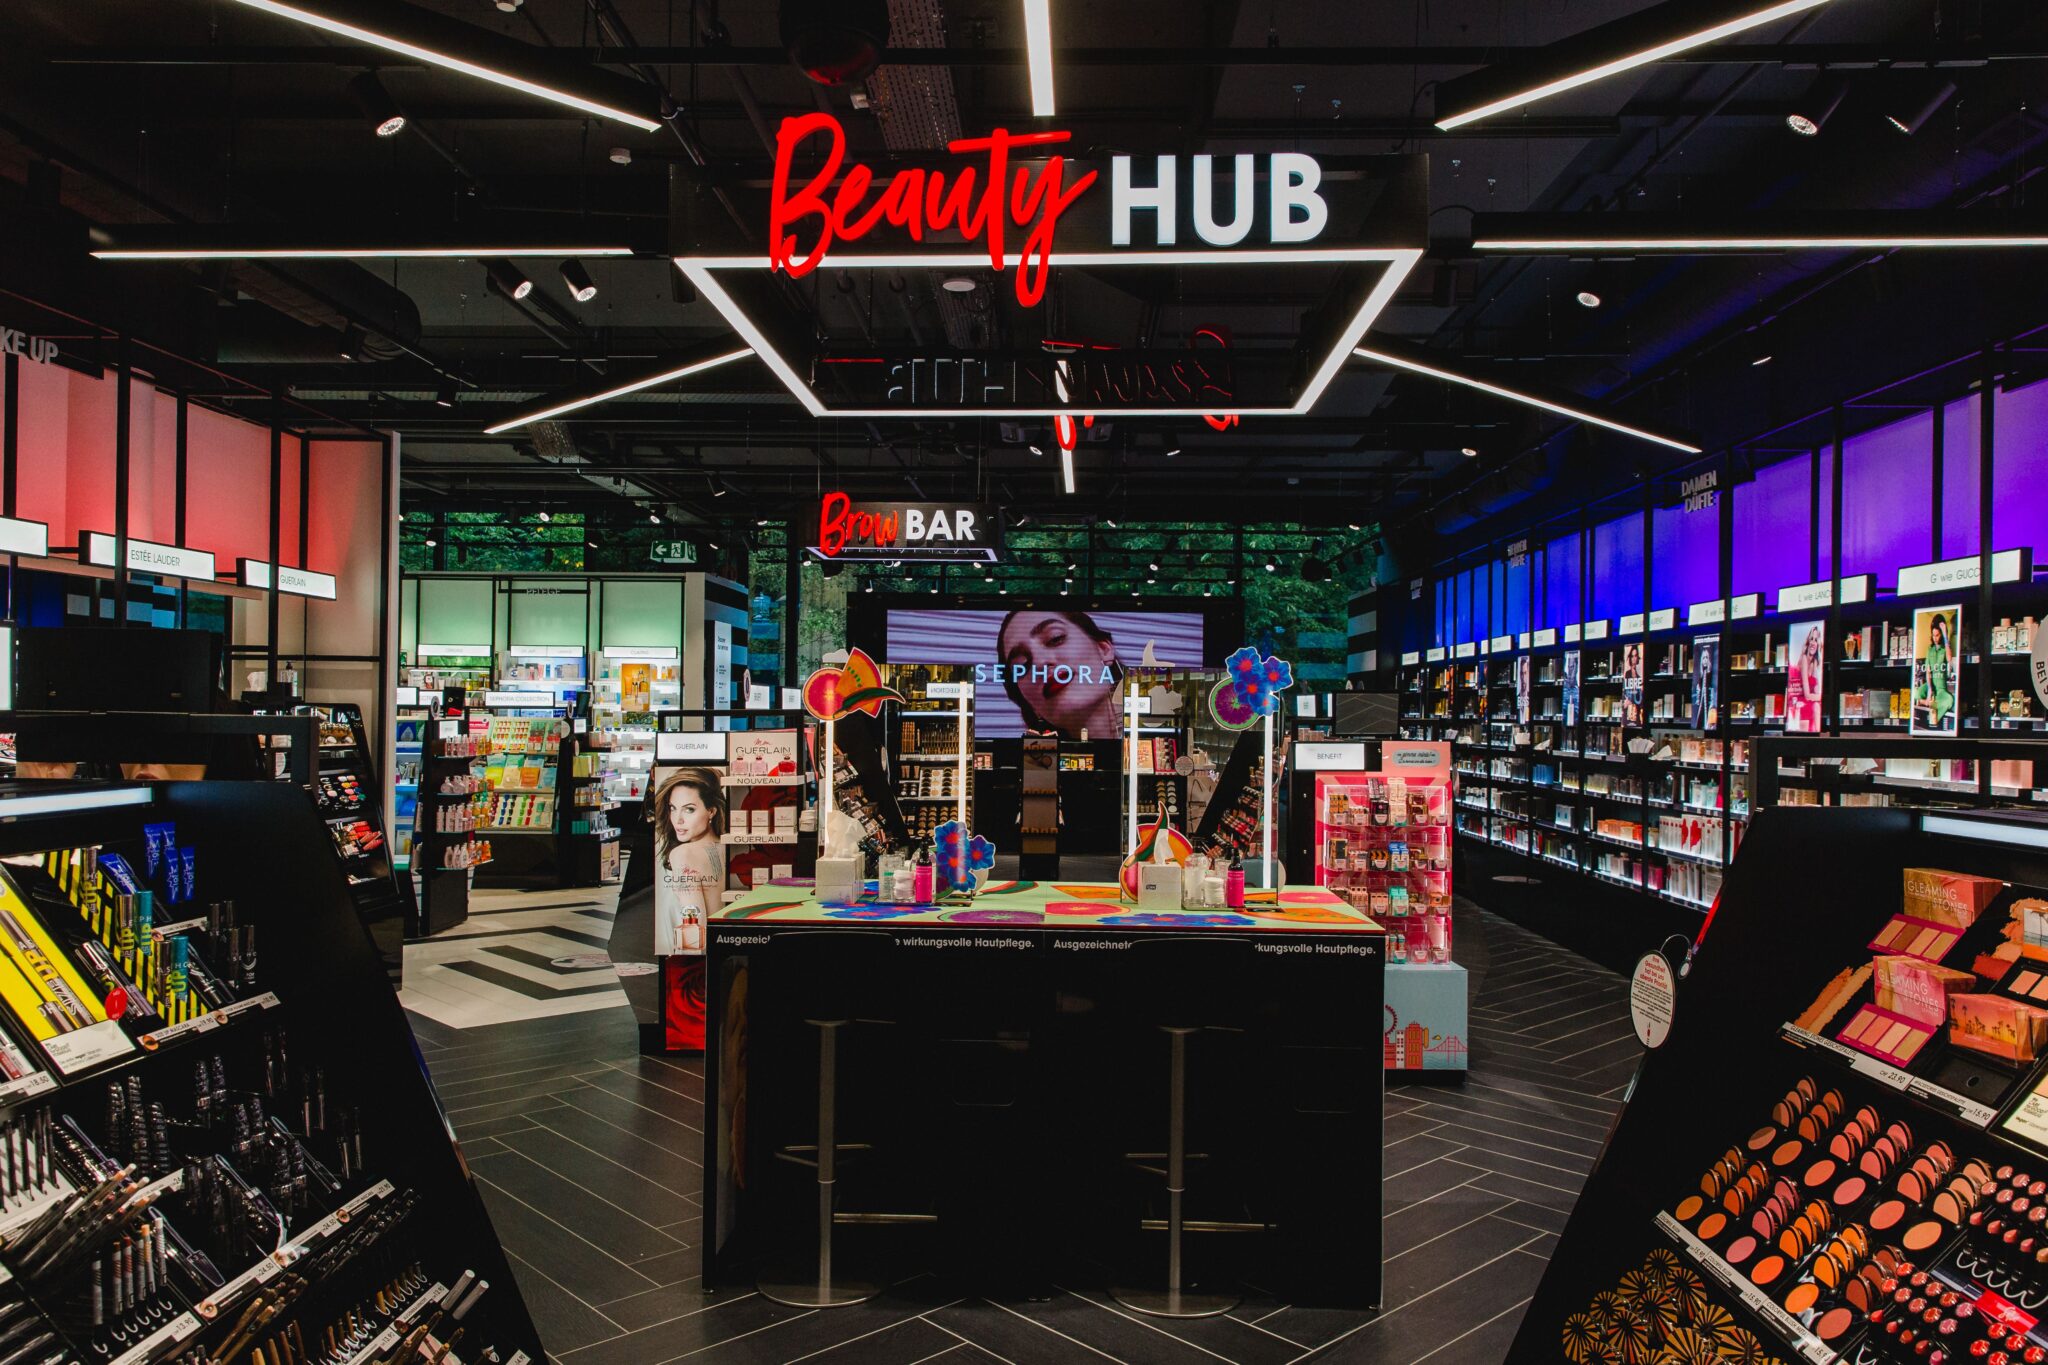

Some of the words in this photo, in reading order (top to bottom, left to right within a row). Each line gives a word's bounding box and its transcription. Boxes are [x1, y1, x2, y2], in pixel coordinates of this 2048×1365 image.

[770, 112, 1098, 307] Beauty
[1111, 152, 1328, 248] HUB
[30, 336, 59, 366] UP
[1681, 470, 1718, 496] DAMEN
[1685, 489, 1714, 513] DÜFTE
[820, 491, 898, 557] Brow
[905, 509, 976, 542] BAR
[131, 549, 152, 562] ESTÉE
[153, 553, 181, 566] LAUDER
[280, 574, 306, 587] GUERLAIN
[1930, 573, 1937, 583] G
[1940, 572, 1953, 582] wie
[1956, 567, 1981, 580] GUCC
[1815, 589, 1832, 600] LANC
[976, 663, 1115, 685] SEPHORA
[1625, 678, 1643, 690] LIBRE
[736, 746, 791, 755] GUERLAIN
[1317, 752, 1342, 760] BENEFIT
[664, 875, 719, 883] GUERLAIN
[1907, 880, 1957, 899] GLEAMING
[1932, 898, 1968, 913] STONES
[903, 936, 972, 949] wirkungsvolle
[975, 936, 1035, 949] Hautpflege.
[1315, 943, 1376, 956] Hautpflege.
[1878, 968, 1928, 994] GLEAMING
[1903, 991, 1939, 1012] STONES
[170, 1022, 191, 1033] MASCARA
[1888, 1071, 1906, 1084] 23.90
[1972, 1107, 1991, 1121] 15.90
[1747, 1293, 1762, 1306] 15.90
